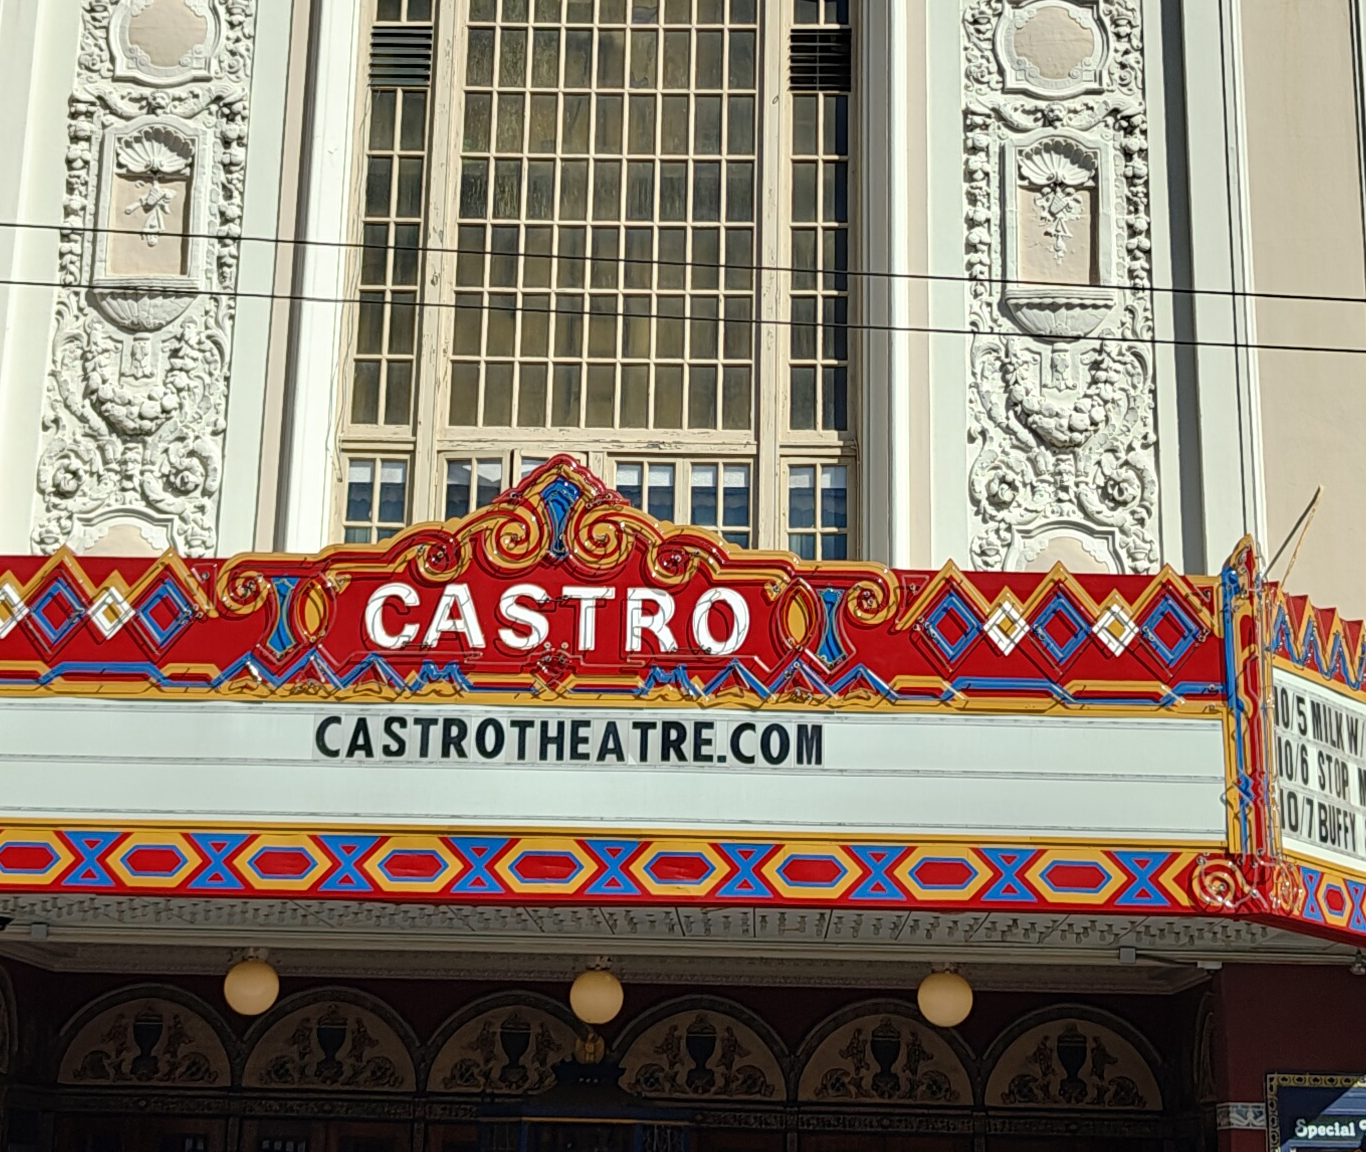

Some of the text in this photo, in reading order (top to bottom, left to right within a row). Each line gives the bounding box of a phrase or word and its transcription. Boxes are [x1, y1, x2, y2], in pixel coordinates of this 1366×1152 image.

[365, 582, 751, 656] CASTRO
[315, 715, 823, 766] CASTROTHEATRE.COM
[1274, 686, 1307, 736] 10/5
[1311, 699, 1344, 750] MILK
[1278, 736, 1309, 786] 10/6
[1318, 751, 1349, 800] STOP
[1280, 789, 1313, 838] 10/7
[1319, 802, 1355, 852] BUFFY
[1295, 1119, 1356, 1139] Special
